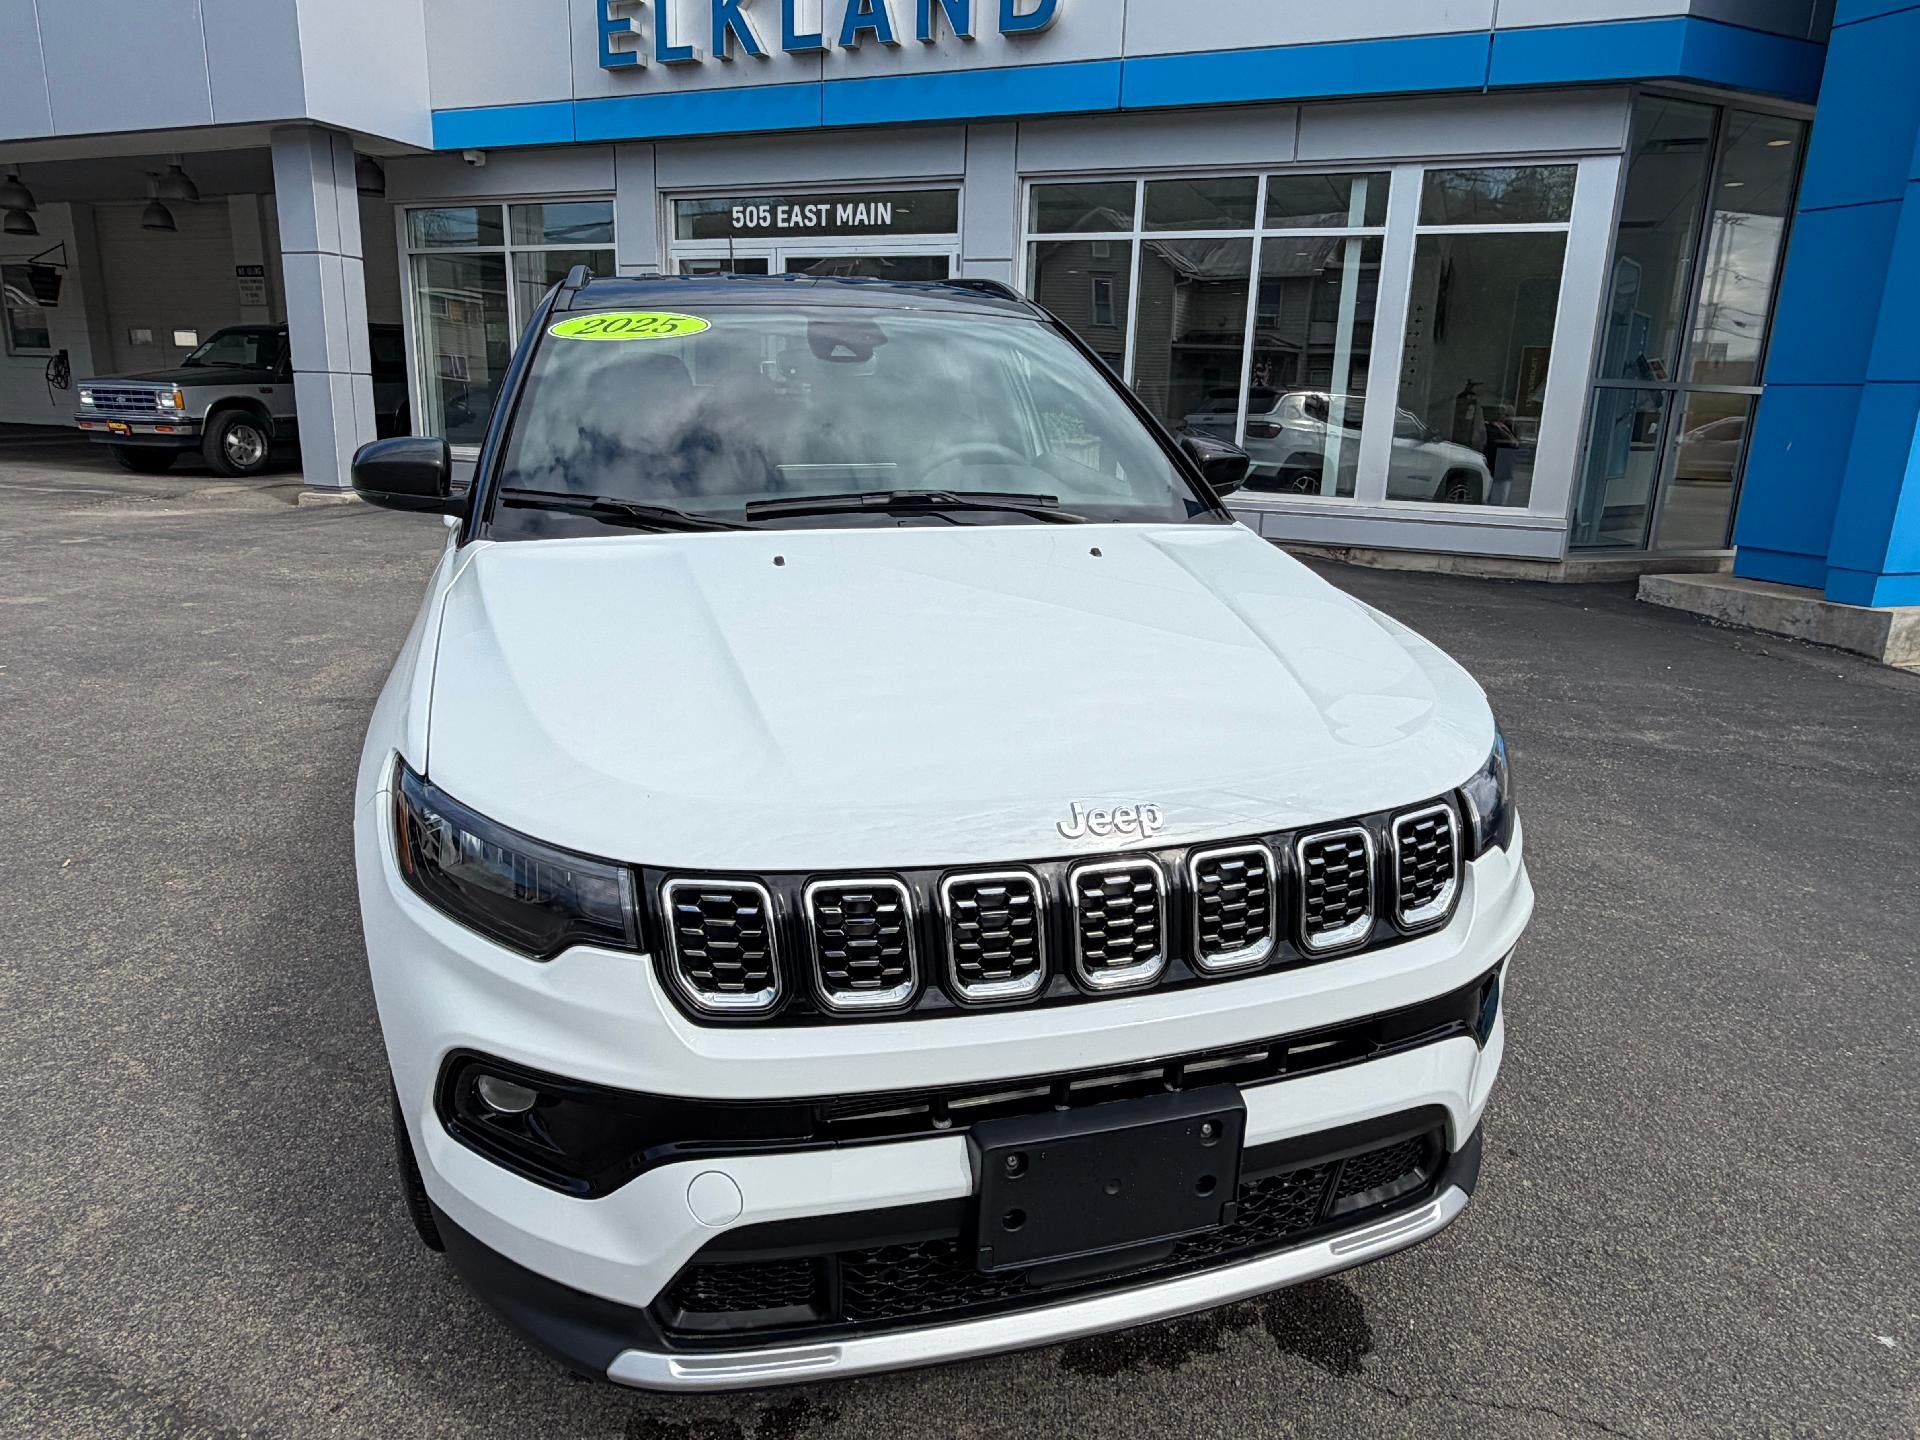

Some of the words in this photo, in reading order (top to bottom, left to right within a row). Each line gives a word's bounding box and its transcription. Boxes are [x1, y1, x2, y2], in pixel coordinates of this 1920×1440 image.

[732, 205, 771, 228] 505
[777, 204, 831, 228] EAST
[836, 202, 892, 226] MAIN
[573, 317, 687, 335] 2025
[1056, 801, 1164, 839] Jeep
